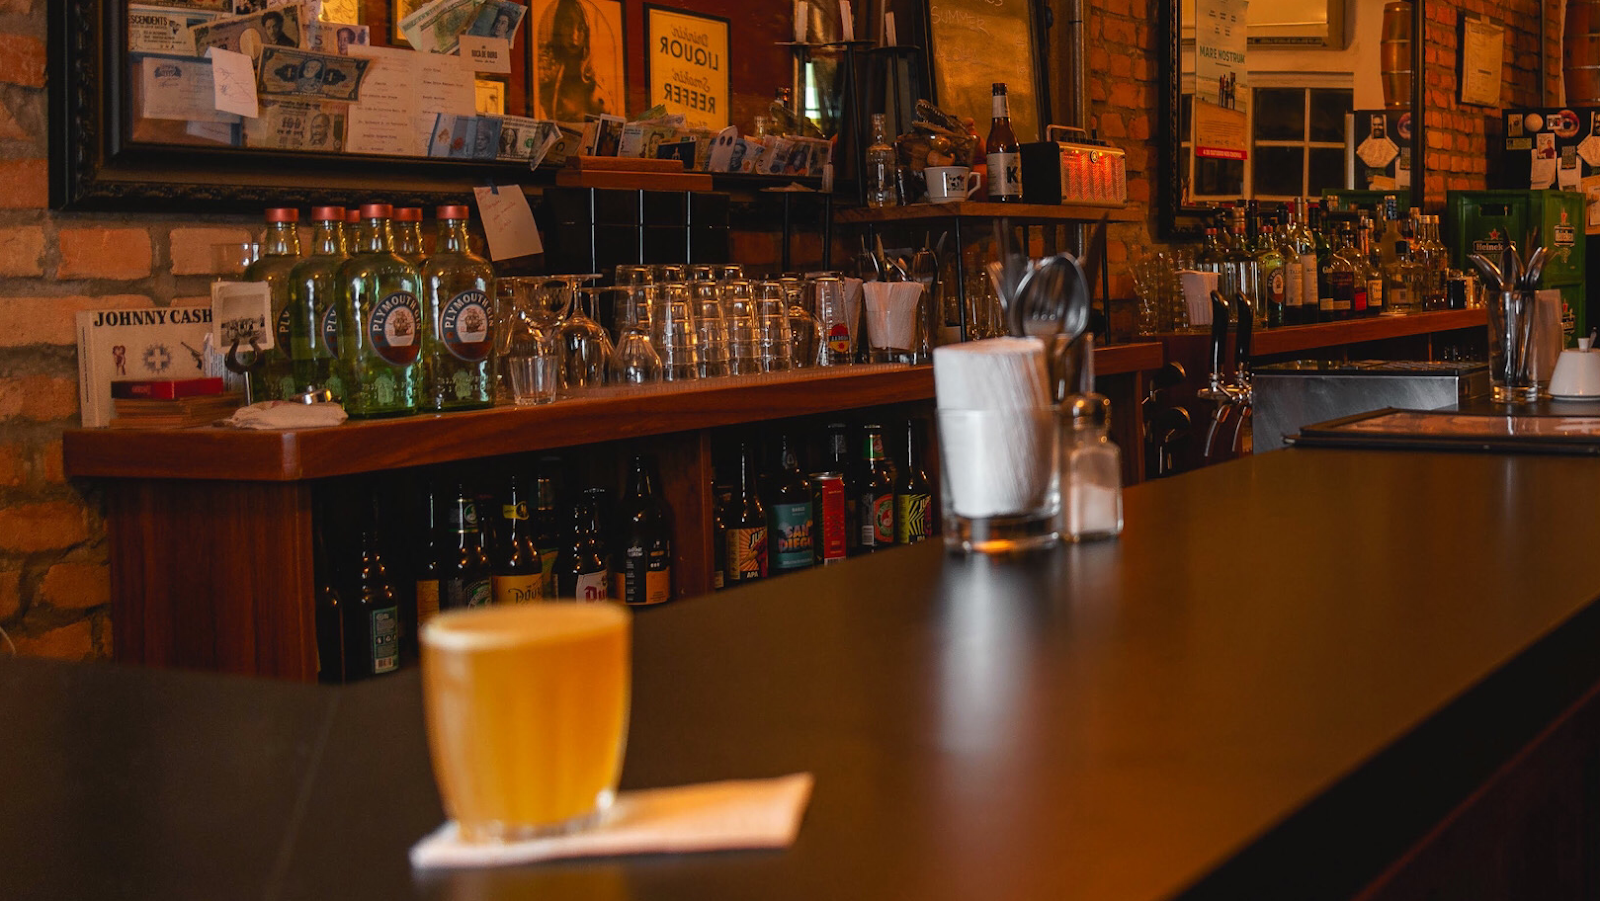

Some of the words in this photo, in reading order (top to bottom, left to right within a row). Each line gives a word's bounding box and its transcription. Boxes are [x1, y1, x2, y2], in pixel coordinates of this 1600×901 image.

[930, 5, 990, 36] SUMMER
[1199, 45, 1217, 59] MARE
[1217, 49, 1246, 65] NOSTRUM
[281, 117, 302, 129] 100
[1006, 166, 1018, 184] K
[1475, 243, 1503, 251] Heinek
[94, 309, 167, 327] JOHNNY
[169, 308, 213, 324] CASH
[372, 294, 417, 332] PLYMOUTH
[445, 292, 488, 328] PLYMOUTH
[486, 306, 494, 327] GIN
[785, 523, 810, 539] SAN
